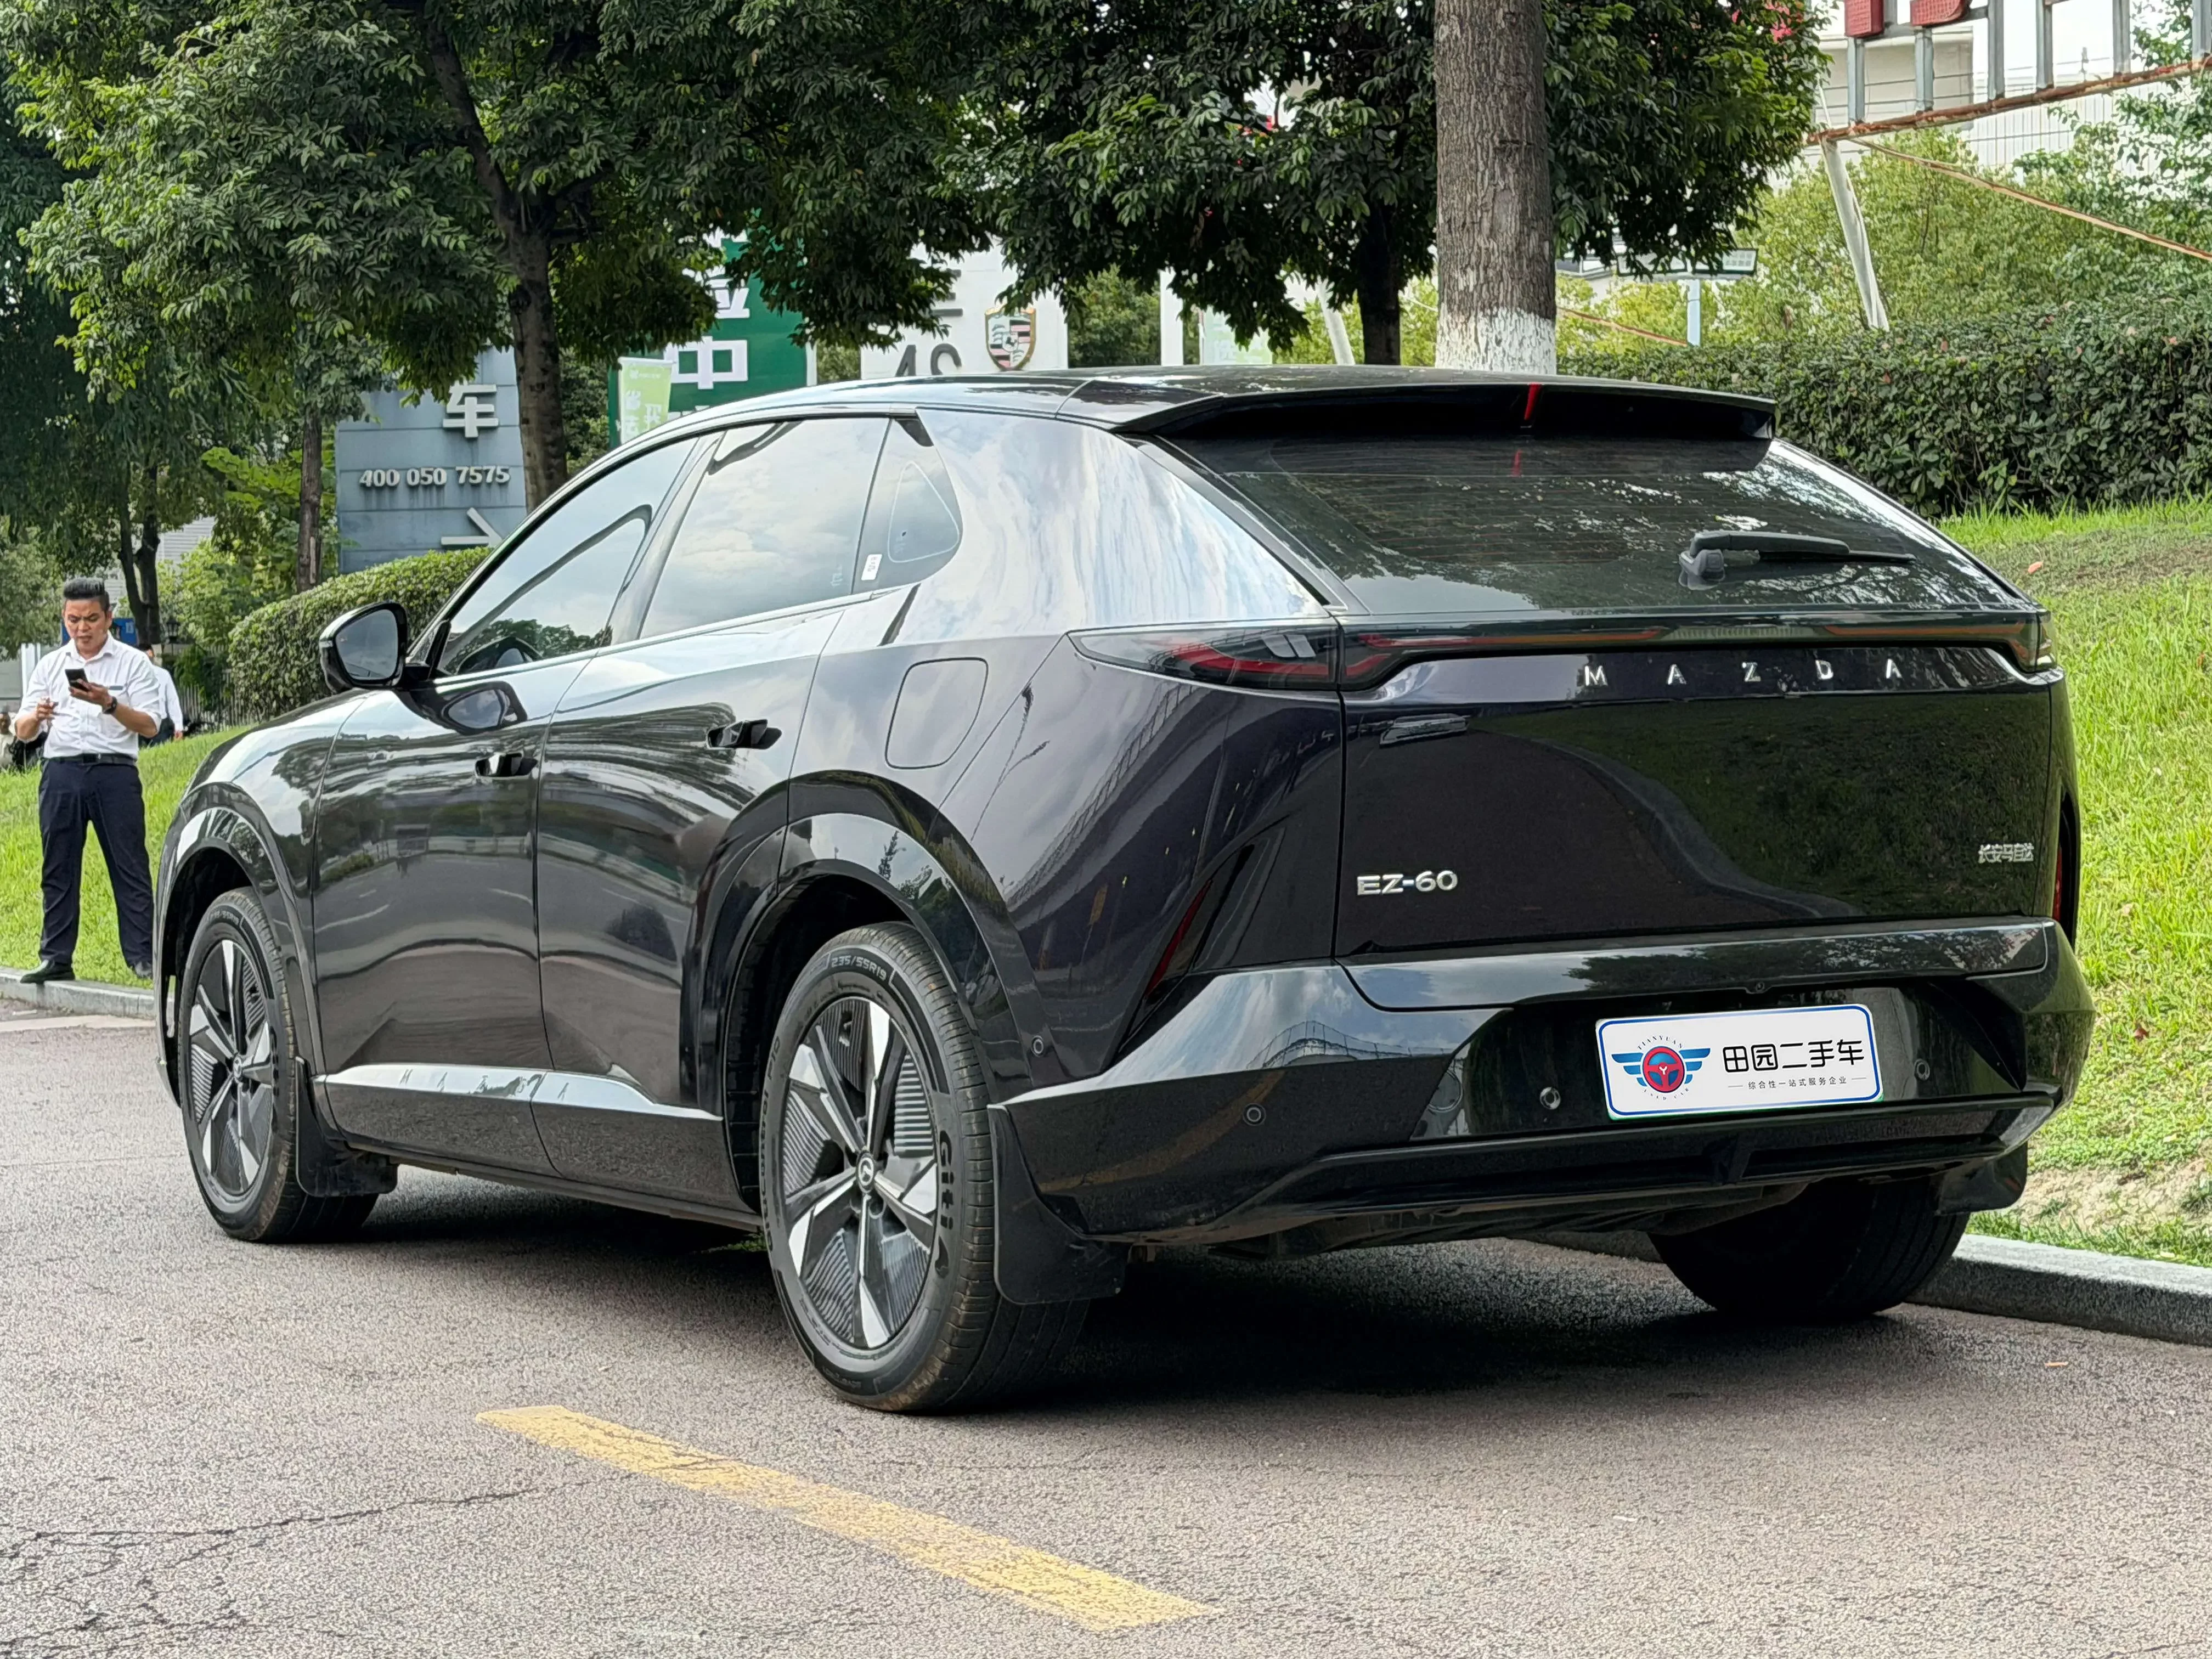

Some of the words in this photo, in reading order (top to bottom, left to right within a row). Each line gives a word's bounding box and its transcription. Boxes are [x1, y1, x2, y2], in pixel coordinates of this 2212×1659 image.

[443, 383, 499, 438] 车
[359, 469, 400, 487] 400
[407, 468, 447, 486] 050
[455, 466, 511, 484] 7575
[1584, 659, 1903, 687] MAZDA
[1357, 870, 1458, 896] EZ-60
[831, 955, 887, 981] 235/55R19
[939, 1130, 955, 1231] Giti
